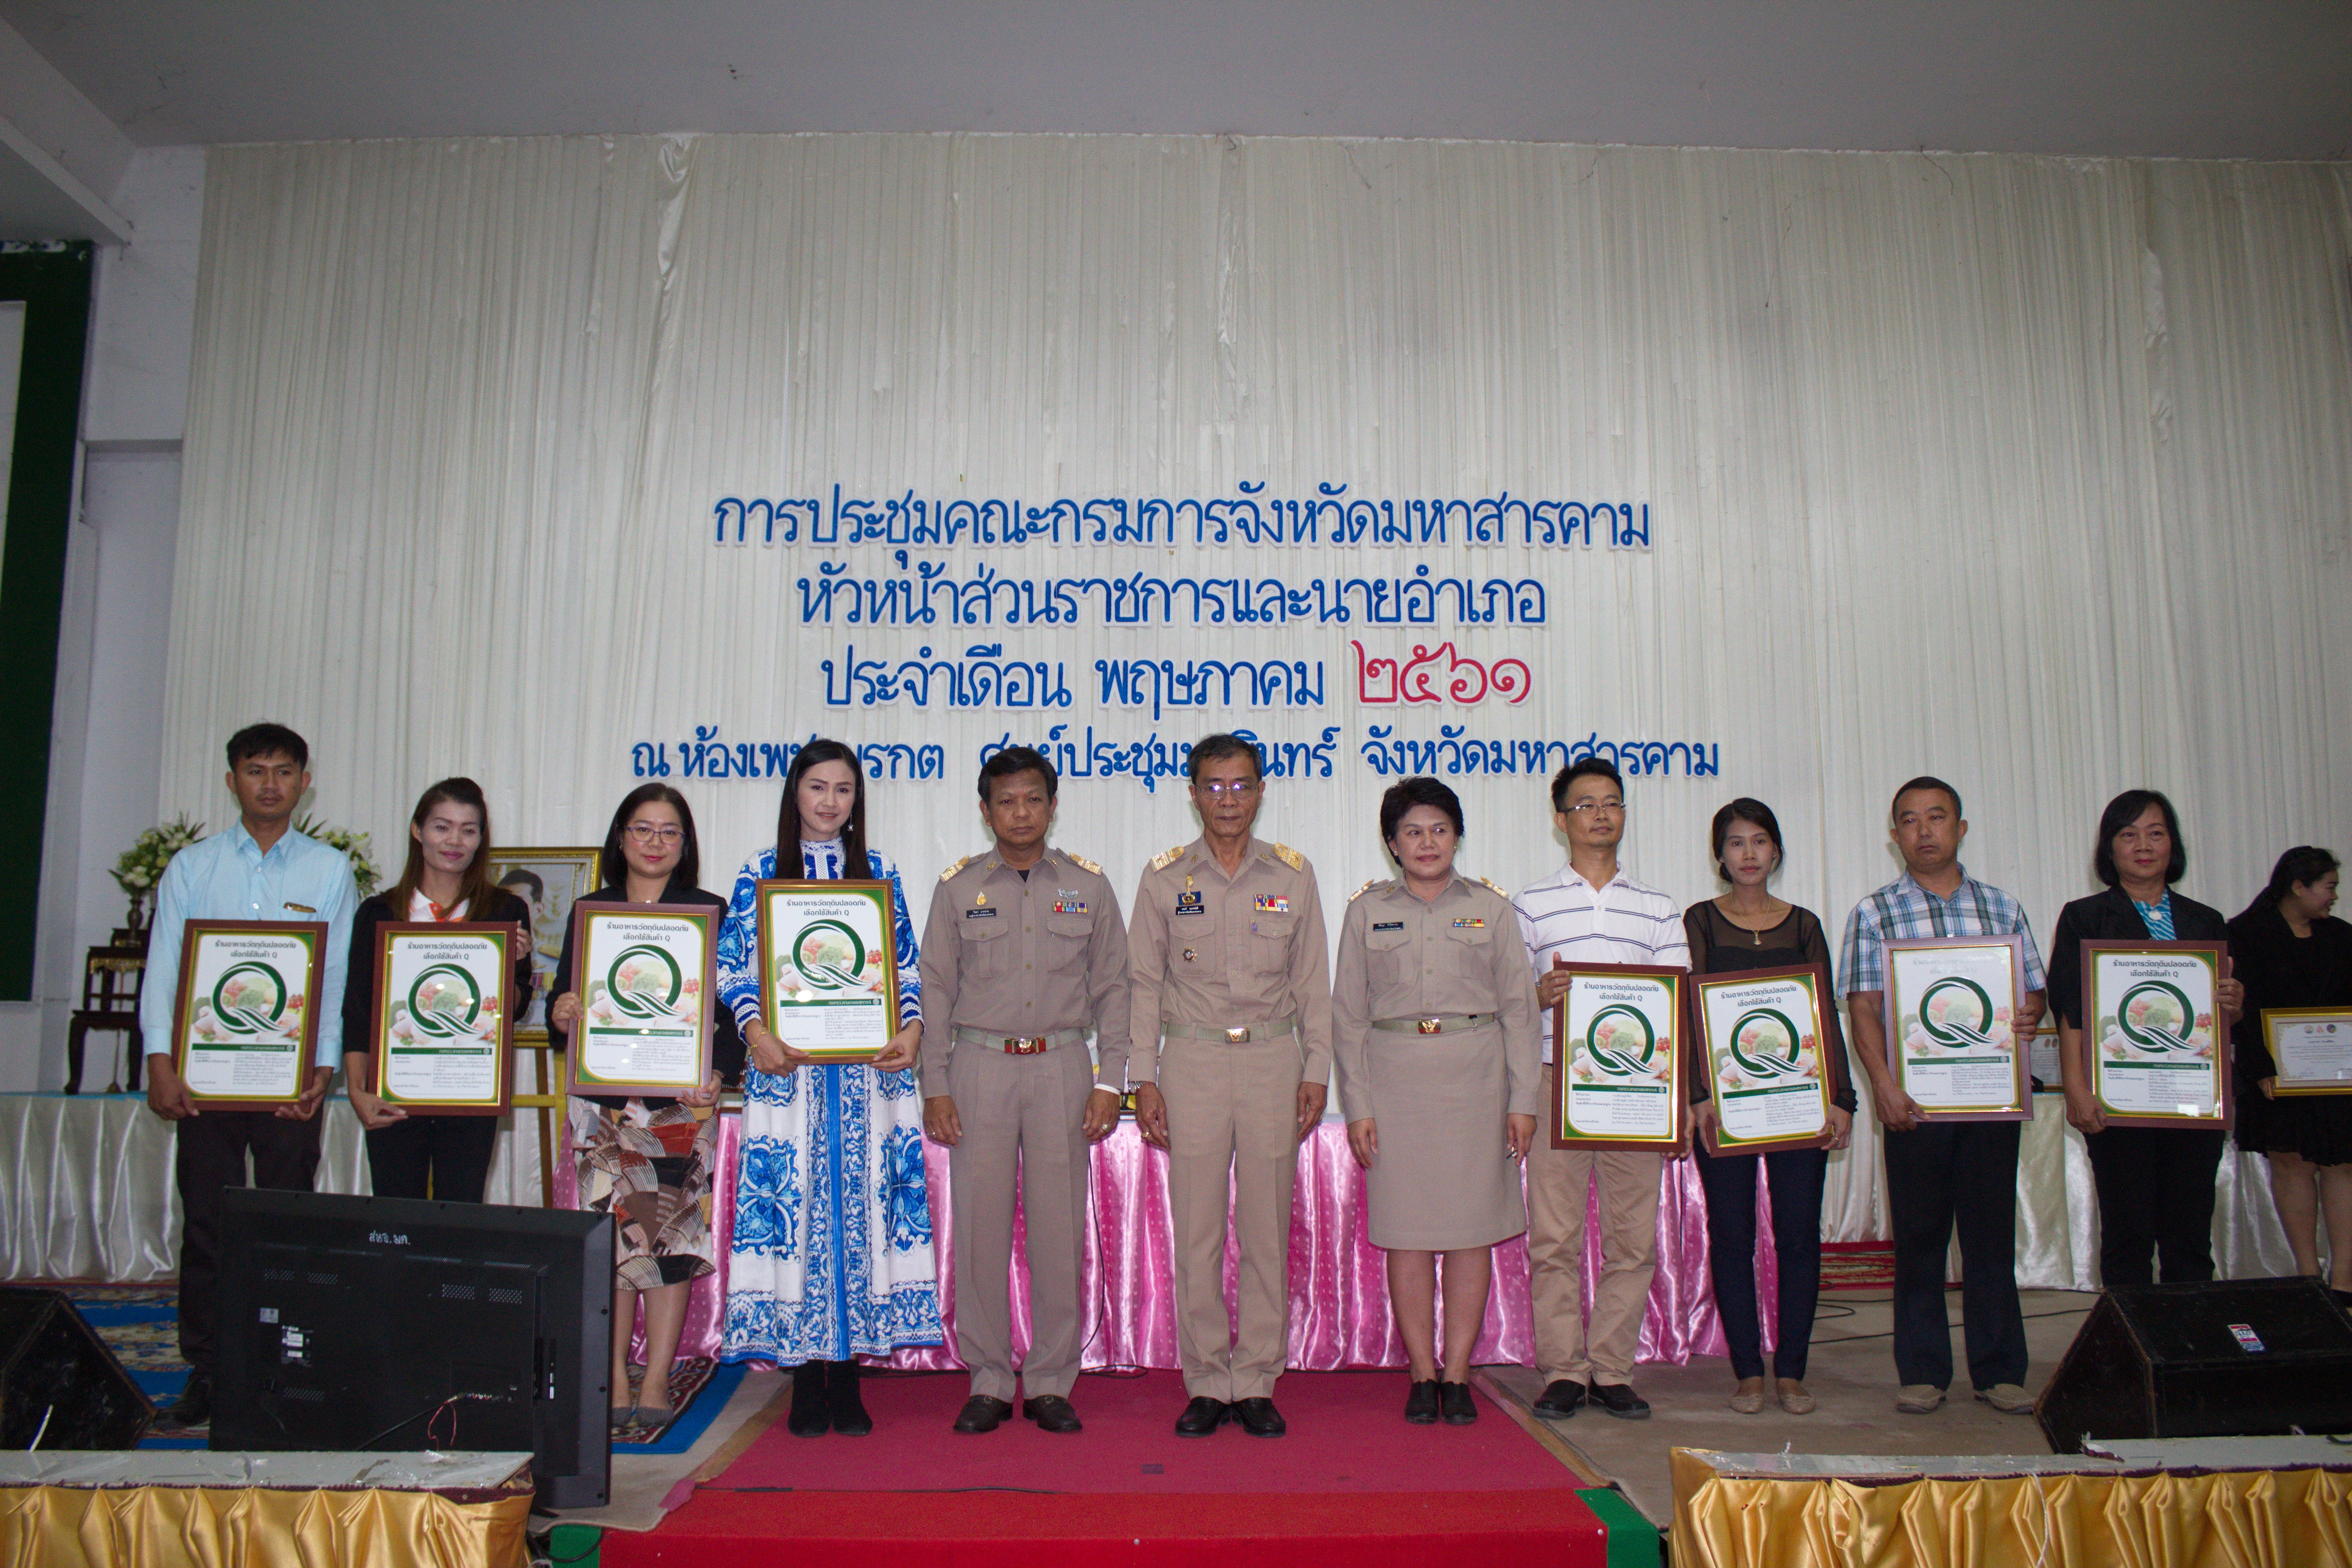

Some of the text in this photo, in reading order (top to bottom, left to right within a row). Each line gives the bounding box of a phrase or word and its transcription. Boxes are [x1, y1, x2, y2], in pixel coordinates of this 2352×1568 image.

[715, 481, 1650, 570] การประชุมคณะกรมการจังหวัดมหาสารคาม
[797, 562, 1546, 624] หัวหน้าส่วนราชการและนายอำเภอ
[821, 640, 1531, 721] ประจำเดือน พฤษภาคม ๒๕๖๑
[679, 726, 945, 779] ห้องเพรกต
[1361, 725, 1719, 777] จังหวัดมหาสารคาม
[786, 899, 866, 908] ร้านอาหารวัตถุดิบปลอดภัย
[607, 921, 689, 932] ร้านอาหารวัตถุดิบปลอดภัย
[622, 933, 662, 941] เลือกใช้สินค้า
[407, 941, 487, 951] ร้านอาหารวัตถุดิบปลอดภัย
[423, 952, 462, 960] เลือกใช้สินค้า
[2112, 959, 2197, 970] ร้านอาหารวัตถุดิบปลอดภัย
[2130, 969, 2171, 978] เลือกใช้สินค้า
[1583, 982, 1659, 993] ร้านอาหารวัตถุดิบปลอดภัย
[1720, 985, 1797, 999] ร้านอาหารวัตถุดิบปลอดภัย
[1599, 993, 1636, 1001] เลือกใช้สินค้า
[1738, 998, 1774, 1007] เลือกใช้สินค้า
